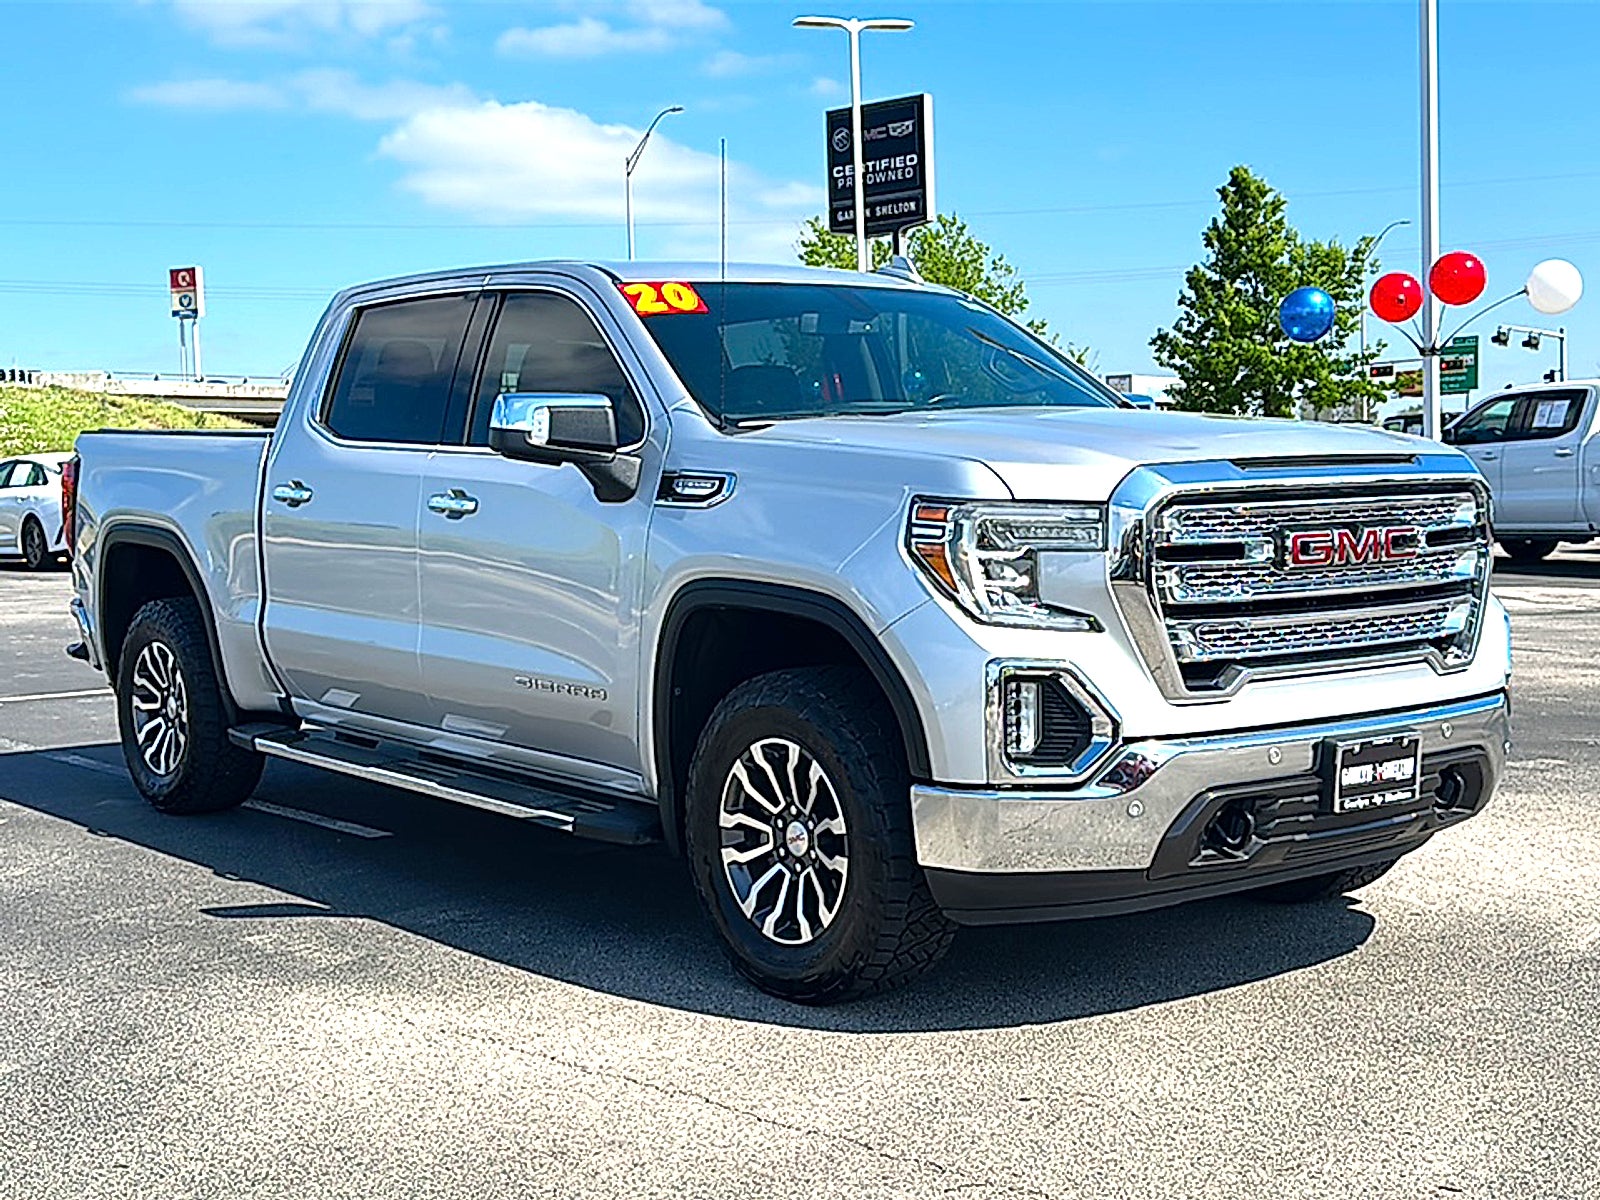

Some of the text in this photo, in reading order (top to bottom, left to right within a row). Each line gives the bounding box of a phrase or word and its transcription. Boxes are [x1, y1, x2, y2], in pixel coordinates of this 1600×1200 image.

[863, 126, 887, 142] MC
[833, 154, 918, 177] CETIFIED
[876, 201, 916, 216] SHELTON
[623, 283, 698, 312] 20
[1290, 526, 1418, 565] GMC
[514, 675, 609, 701] SIERRA
